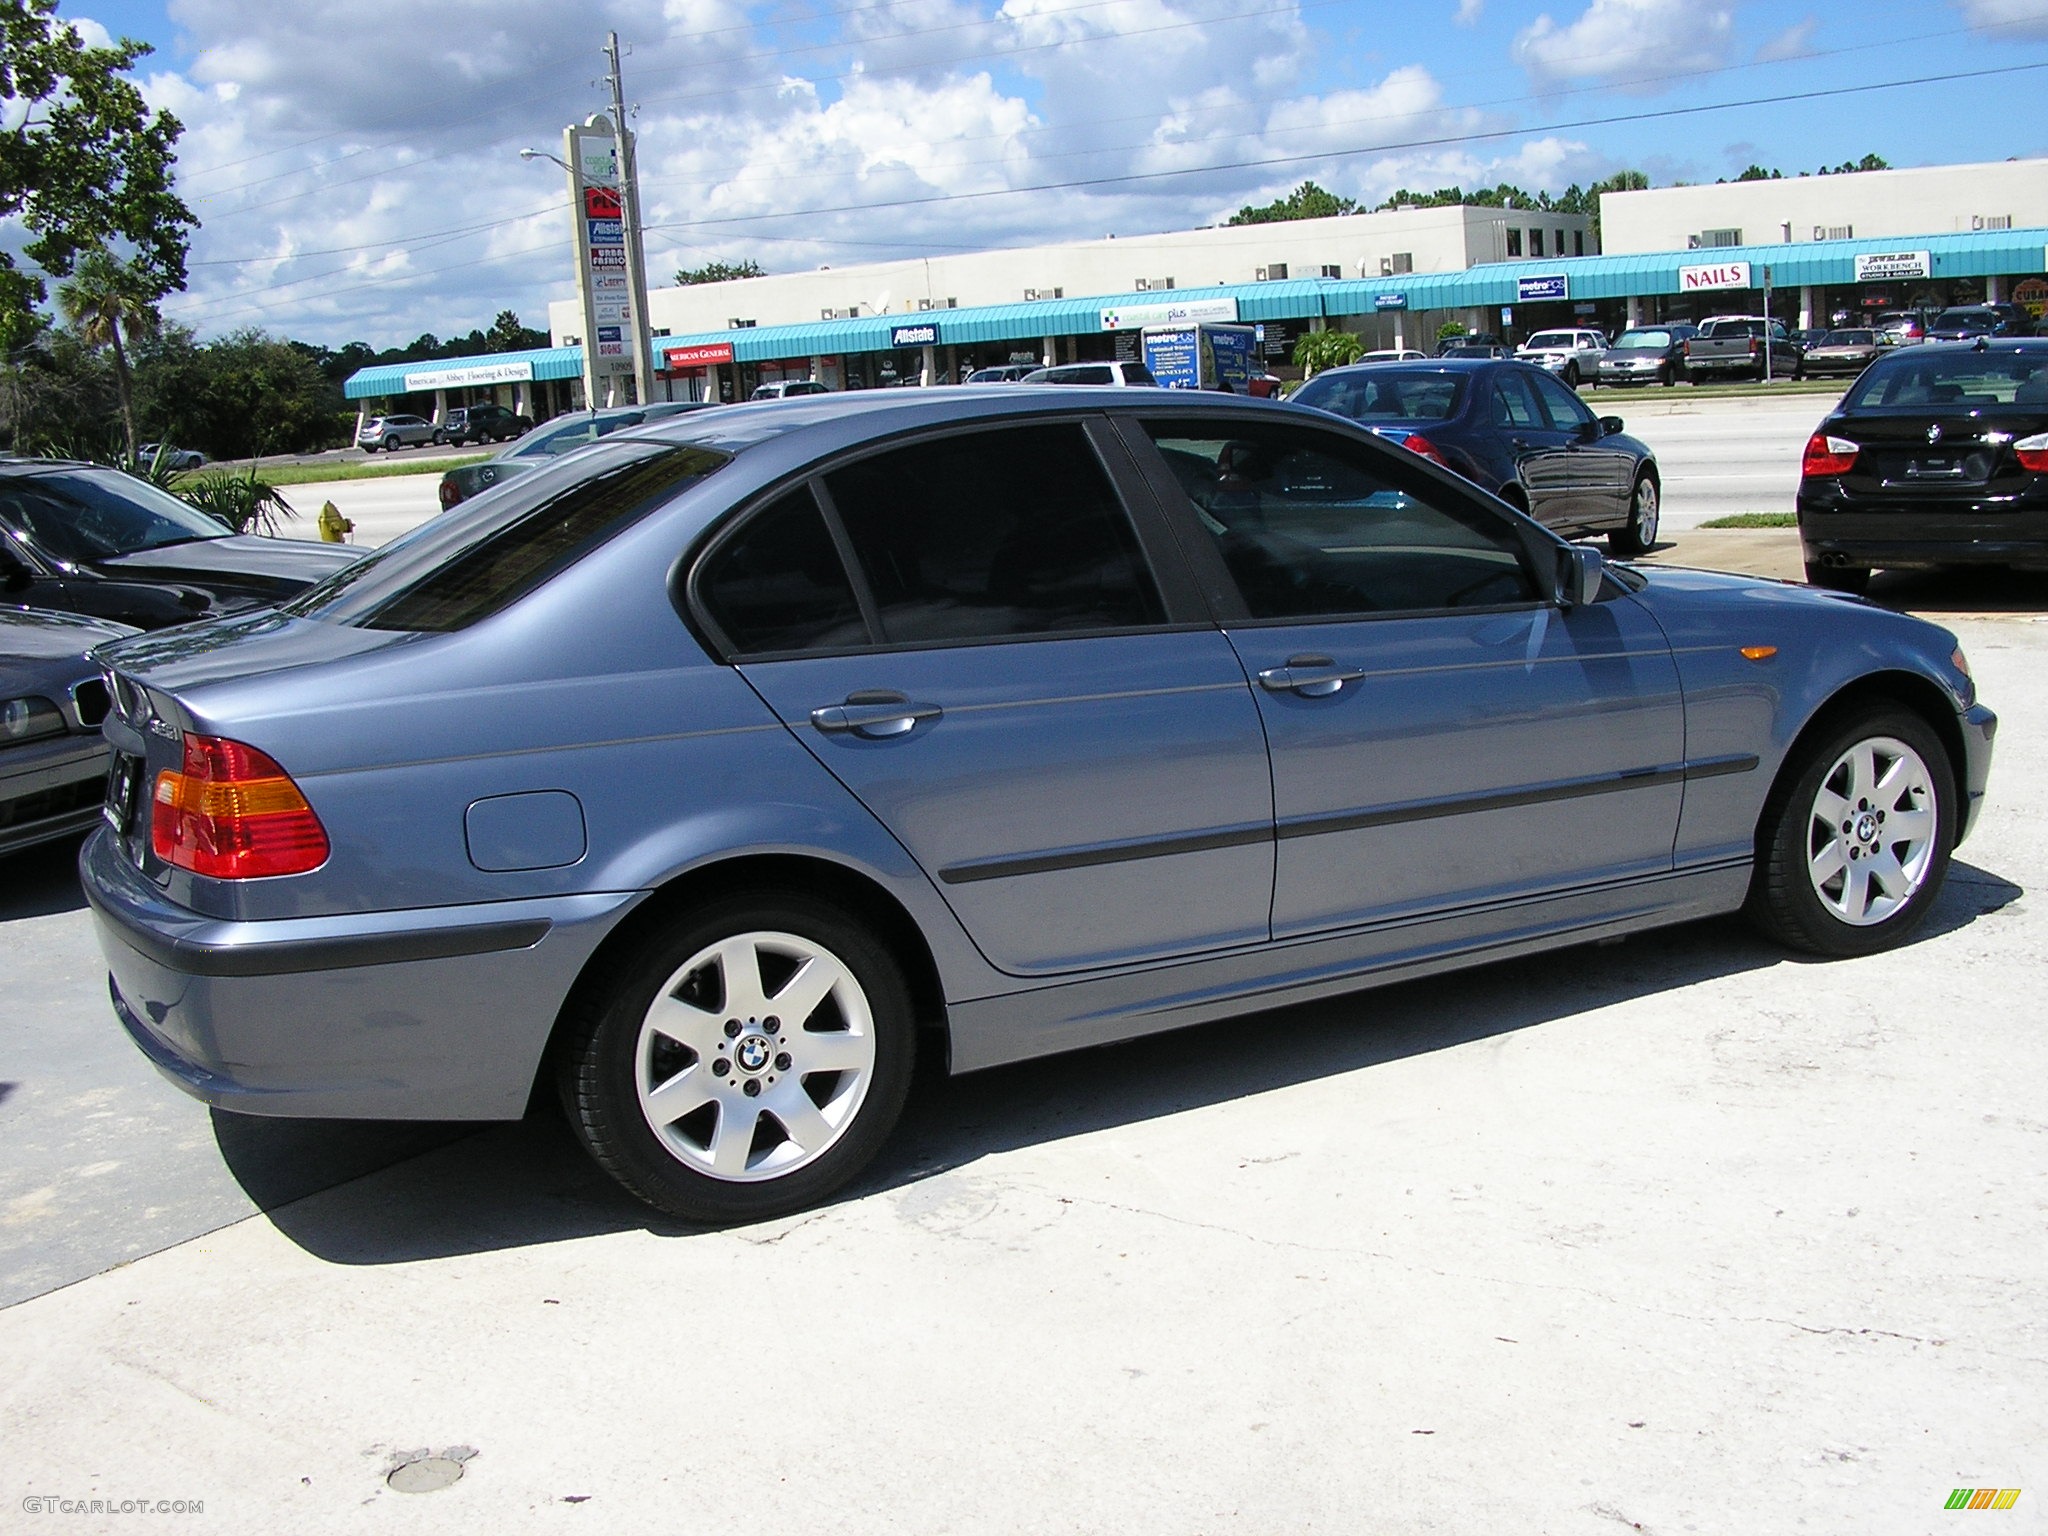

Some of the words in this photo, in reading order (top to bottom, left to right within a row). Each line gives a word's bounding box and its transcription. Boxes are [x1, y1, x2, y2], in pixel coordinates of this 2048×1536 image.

[598, 249, 623, 257] URBA
[593, 257, 625, 265] FASHIO
[1862, 262, 1922, 271] WORKBENCH
[1686, 266, 1741, 289] NAILS
[1520, 280, 1565, 291] metroPCS
[894, 327, 935, 344] Allstate
[699, 348, 731, 359] GENERAL
[408, 375, 437, 385] American
[446, 373, 465, 384] Abbey
[467, 370, 495, 381] Flooring
[497, 370, 503, 378] &
[504, 367, 528, 378] Design
